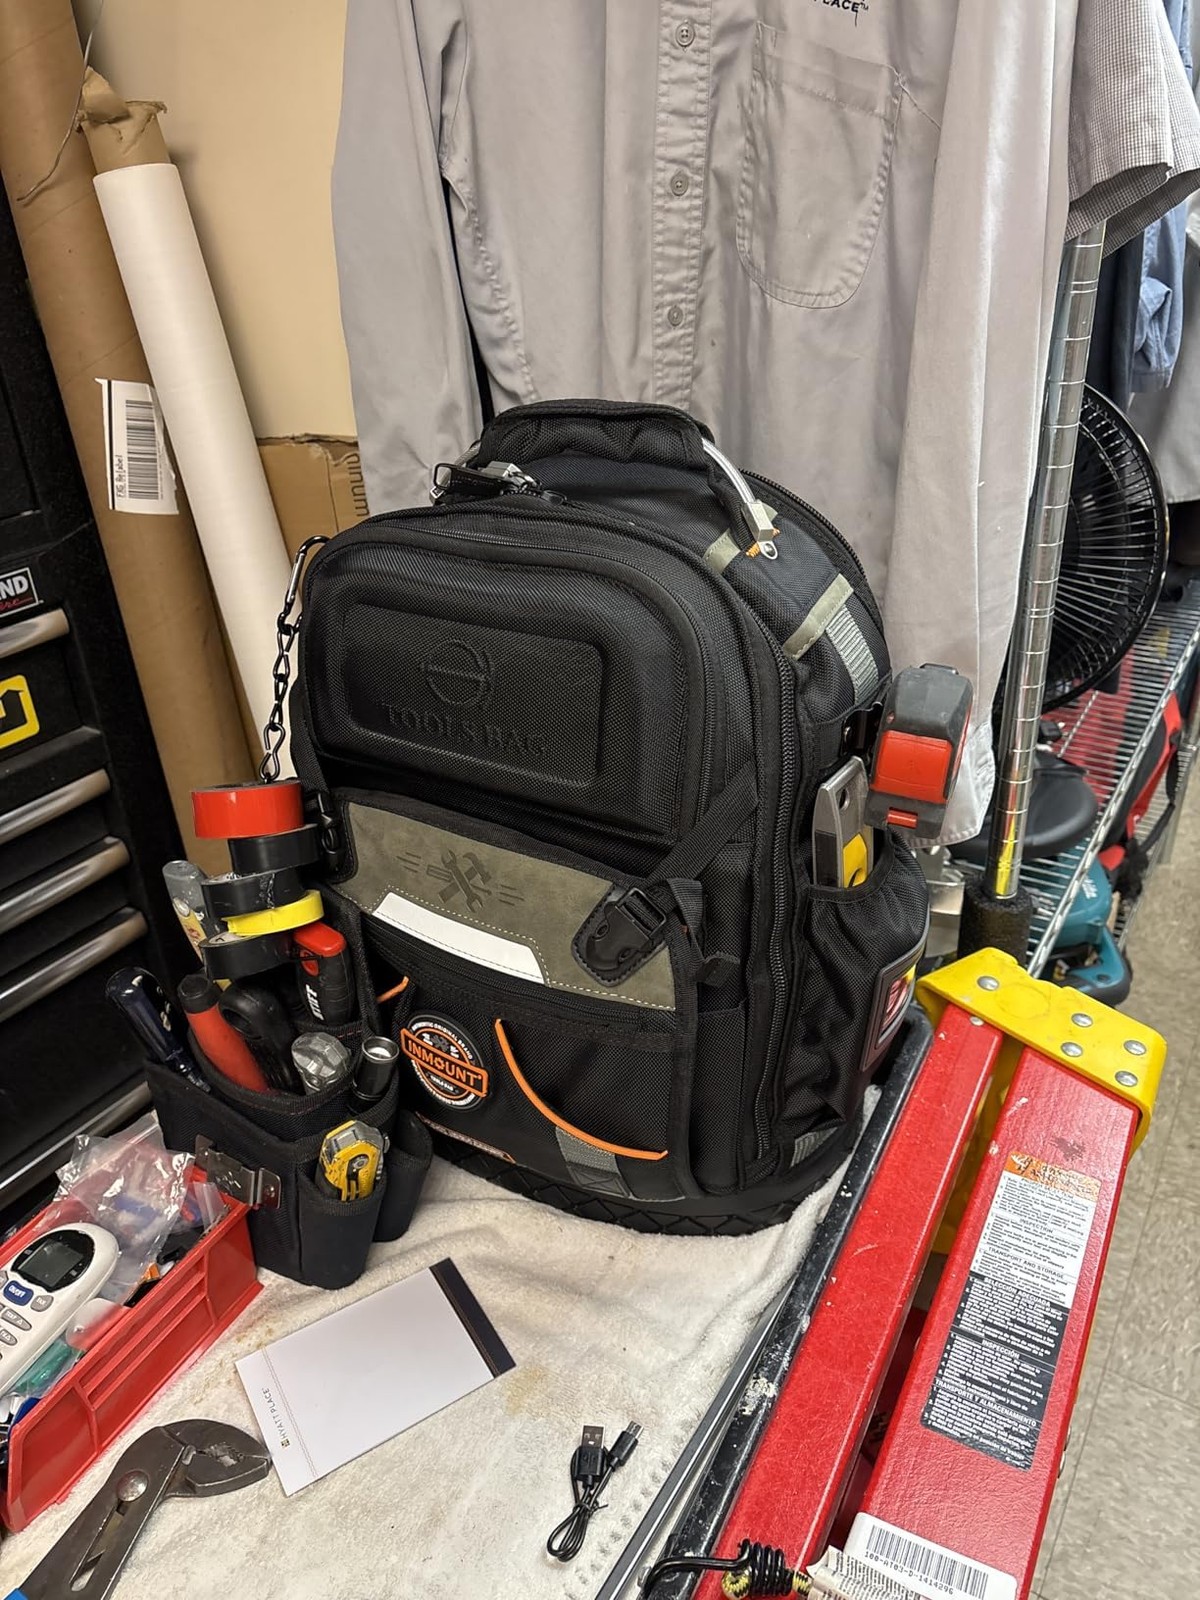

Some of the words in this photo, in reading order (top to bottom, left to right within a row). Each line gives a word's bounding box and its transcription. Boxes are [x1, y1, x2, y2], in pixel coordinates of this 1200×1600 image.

[0, 575, 29, 600] ND
[380, 699, 480, 746] TOOLS
[484, 723, 550, 760] BAG
[1018, 1217, 1053, 1234] INSPECTION
[987, 1246, 1022, 1263] TRANSPORT
[1022, 1259, 1036, 1269] AND
[1036, 1264, 1064, 1279] STORAGE
[262, 1387, 278, 1414] PLACE
[934, 1378, 974, 1400] TRANSPORTE
[978, 1397, 1037, 1428] ALMACENAMIENTO
[272, 1413, 288, 1440] HYATT
